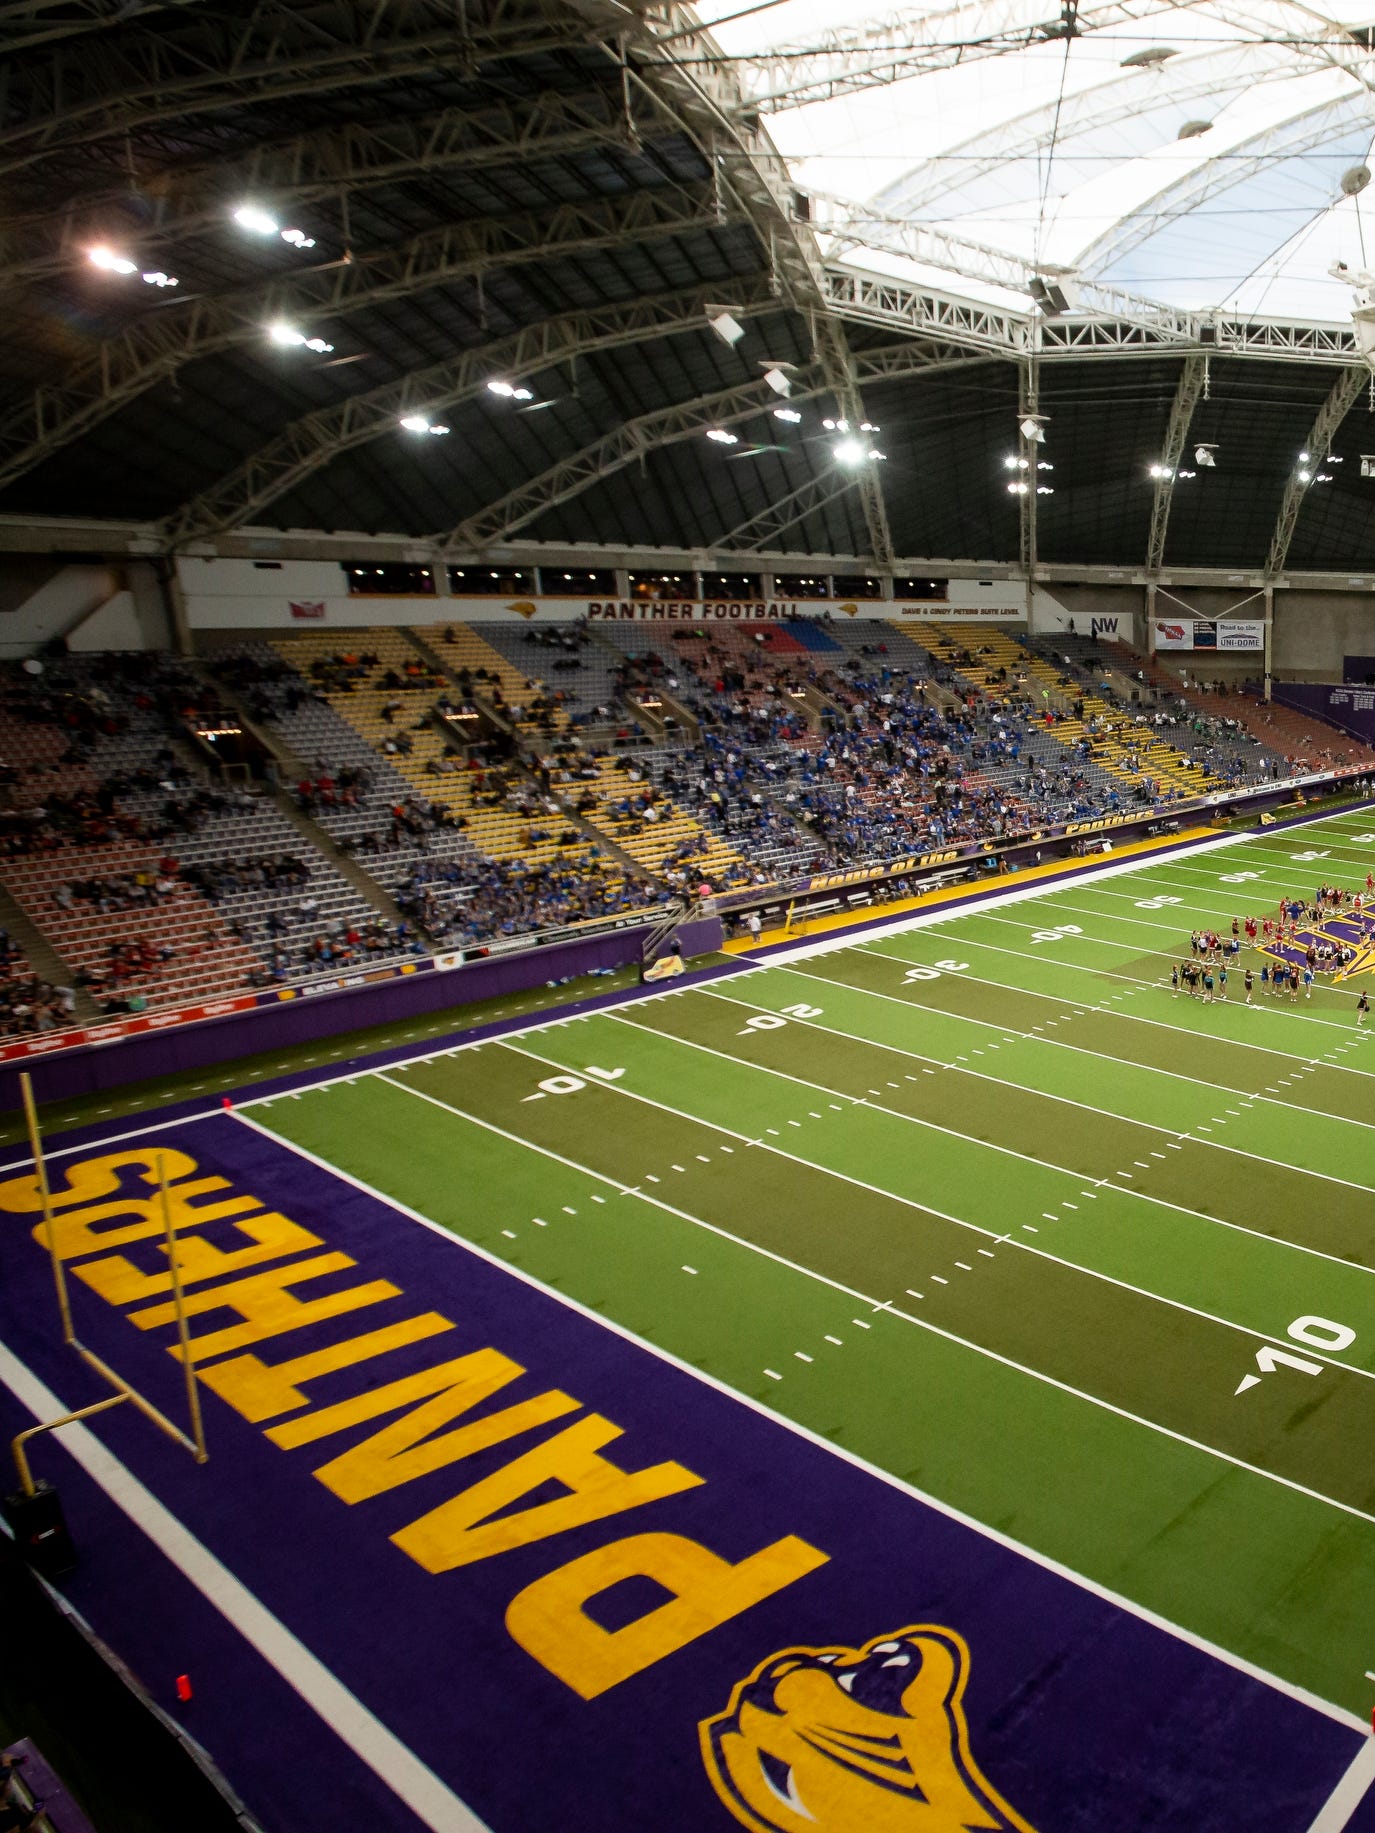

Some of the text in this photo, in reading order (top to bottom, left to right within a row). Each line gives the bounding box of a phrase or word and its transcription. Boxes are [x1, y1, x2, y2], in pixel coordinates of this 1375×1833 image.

[588, 602, 798, 618] PANTHER FOOTBALL
[1091, 617, 1119, 633] NW
[1066, 808, 1154, 835] Panthers
[809, 849, 958, 890] Home of the
[1043, 924, 1083, 942] 40
[911, 958, 970, 983] 30
[752, 1002, 824, 1030] 20
[537, 1065, 627, 1095] 10
[1255, 1314, 1357, 1376] 10
[0, 1147, 832, 1701] PANTHERS
